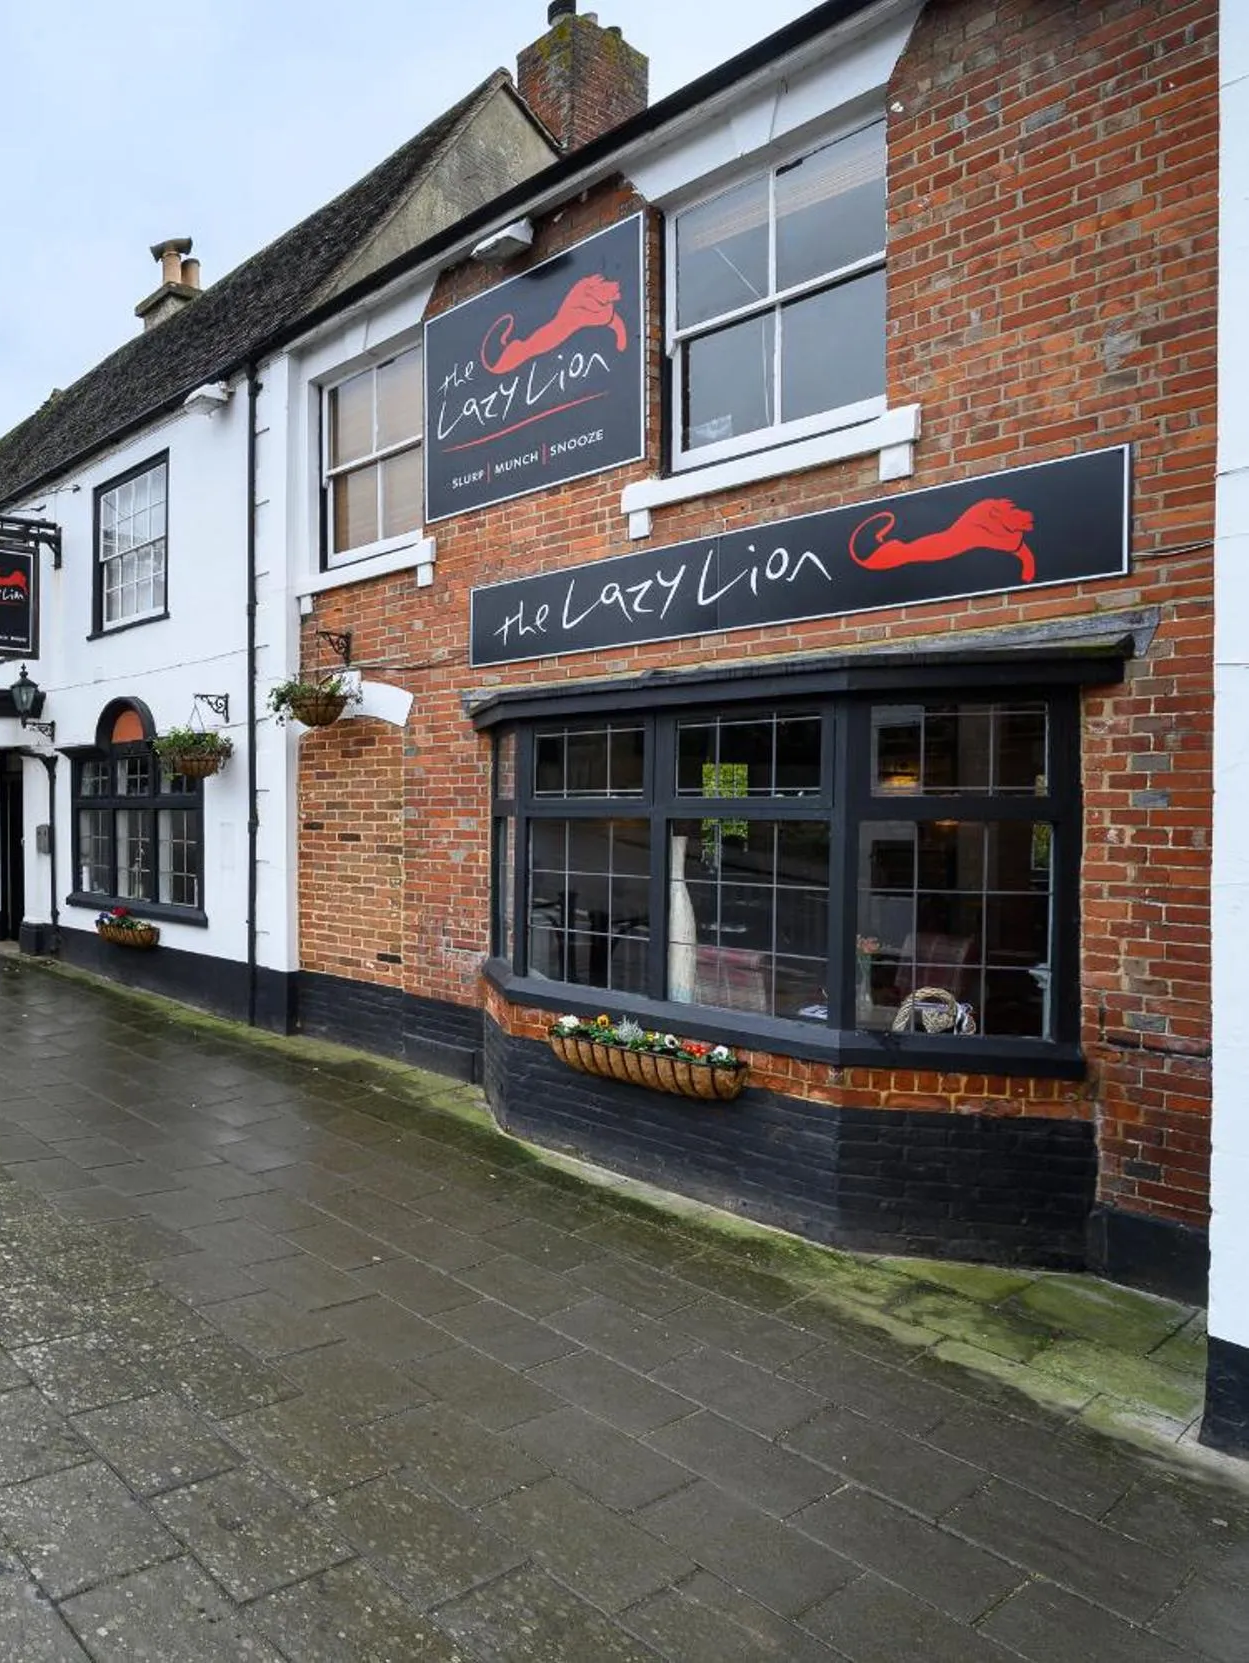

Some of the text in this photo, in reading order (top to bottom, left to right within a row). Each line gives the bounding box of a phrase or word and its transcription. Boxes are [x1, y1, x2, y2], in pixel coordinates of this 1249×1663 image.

[437, 361, 475, 396] the
[452, 428, 604, 490] SLURP MUNCH SNOOZE
[494, 600, 549, 646] the
